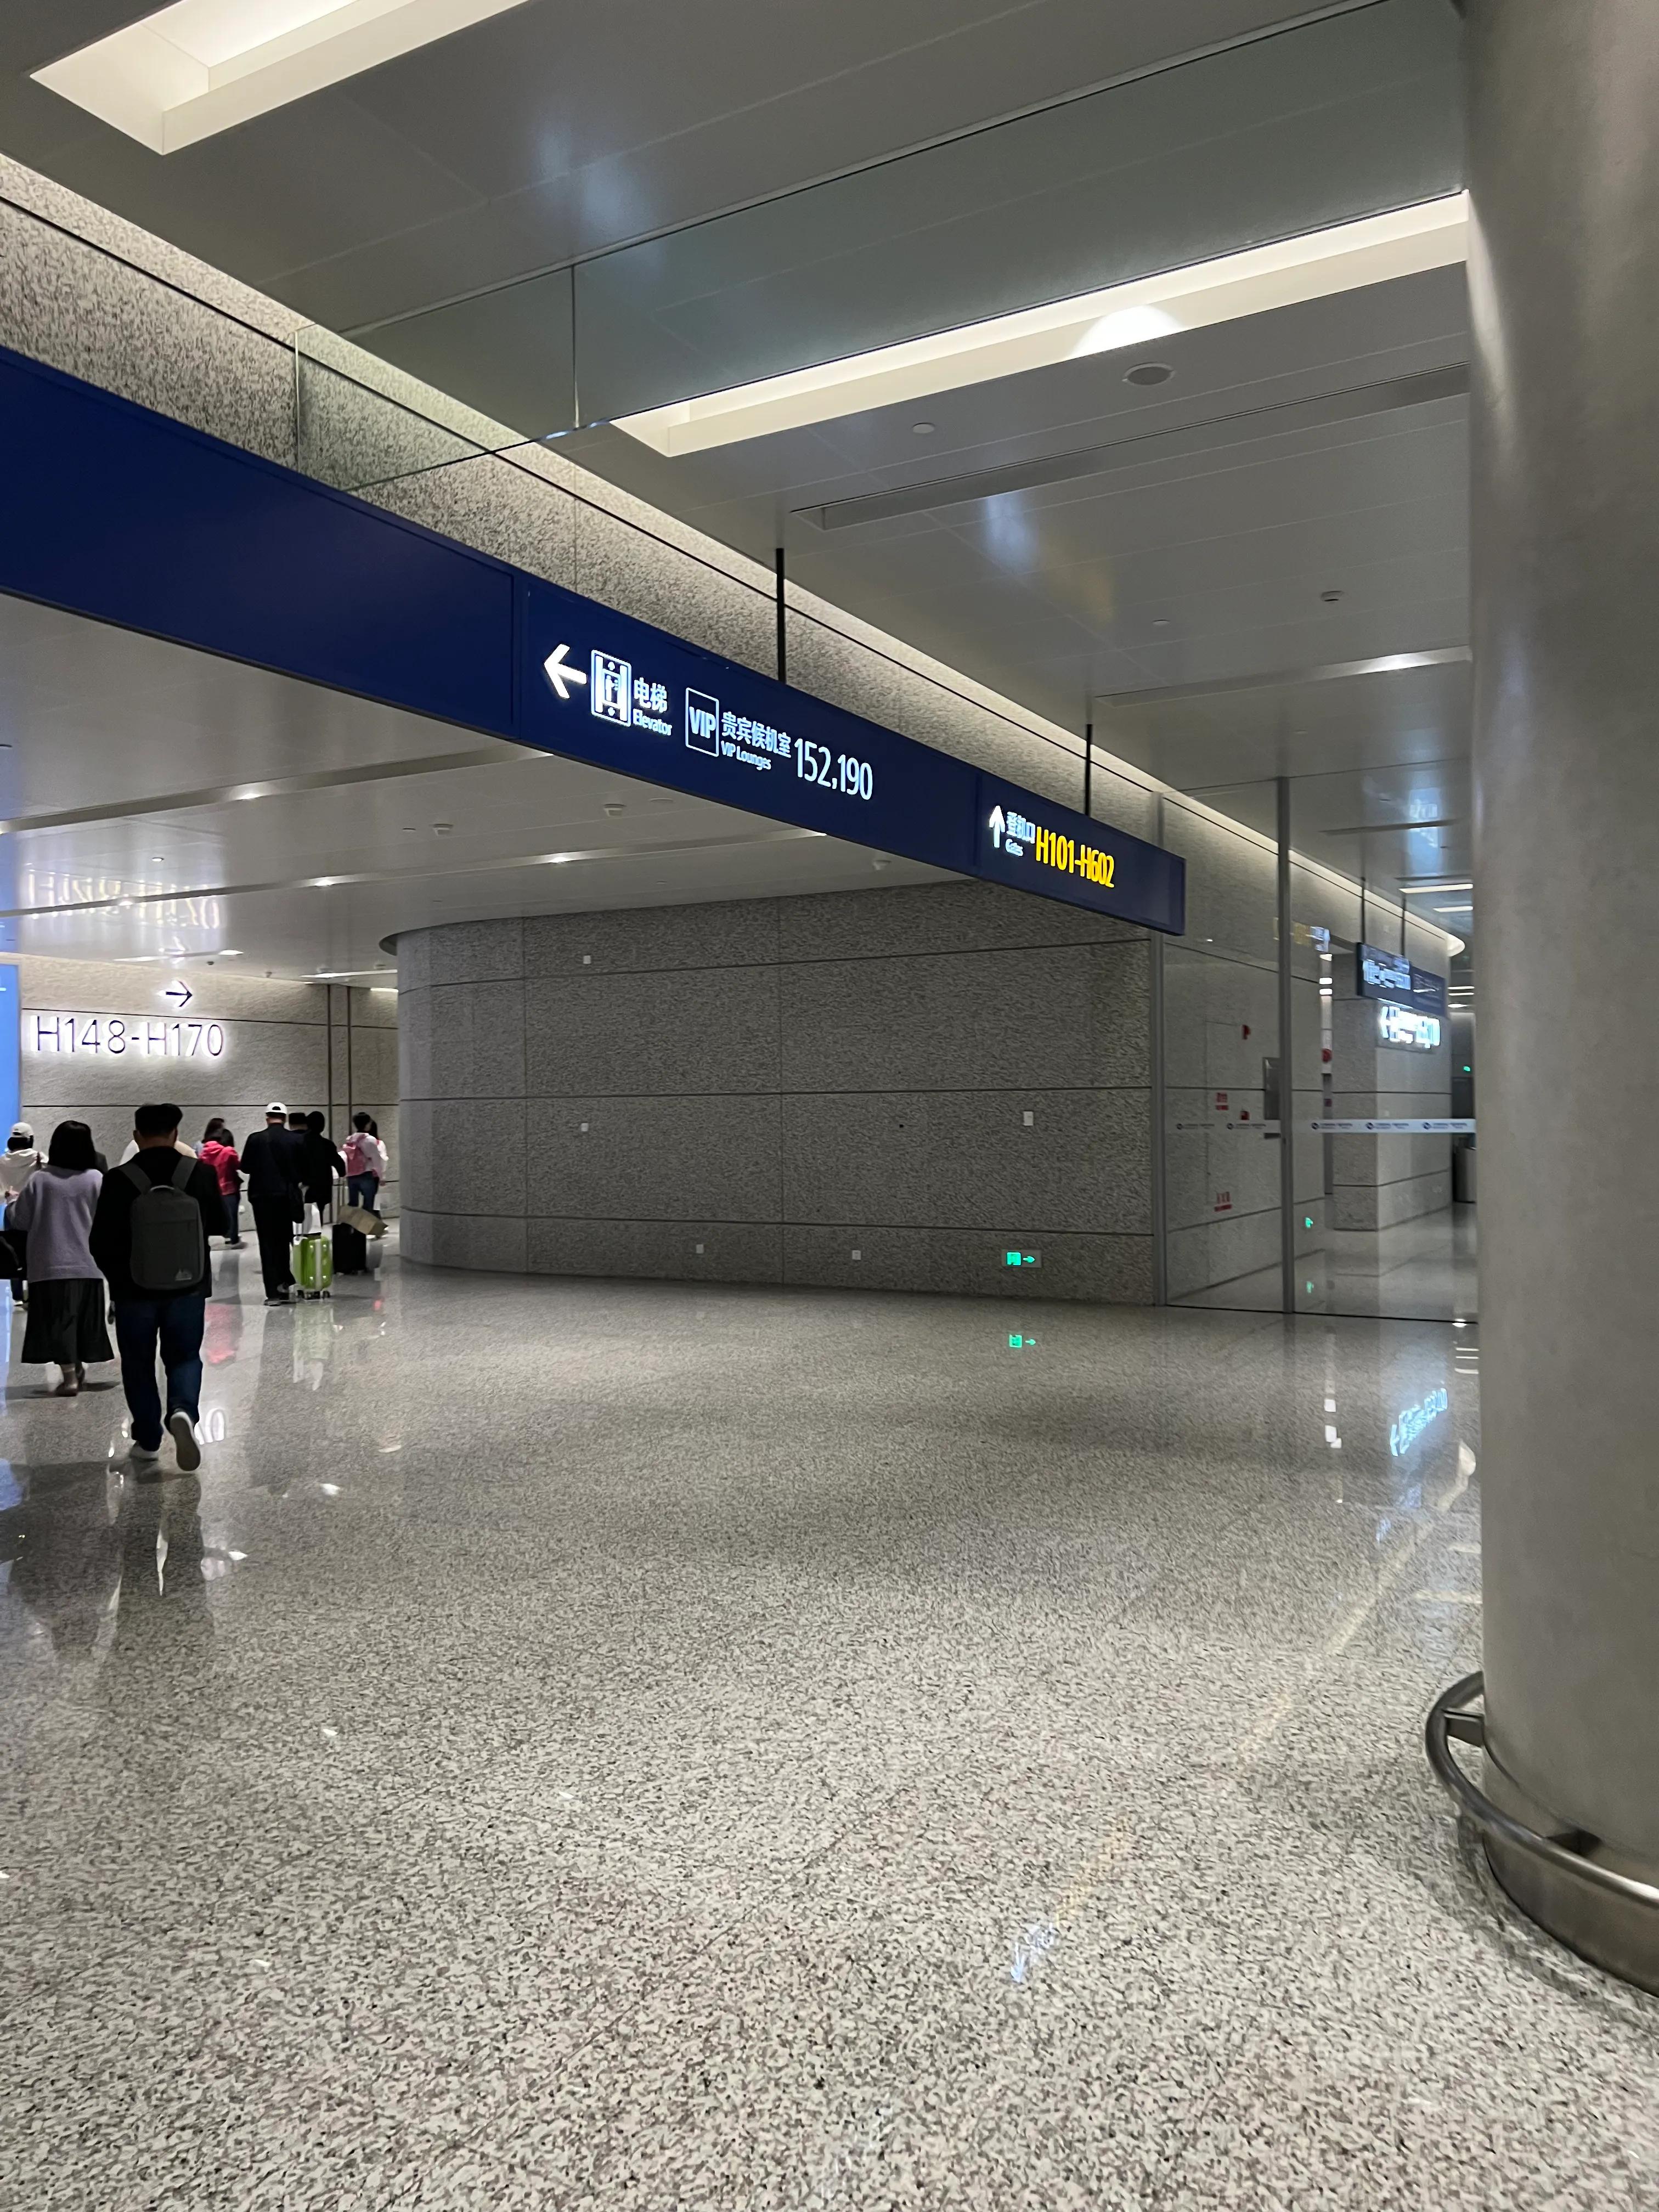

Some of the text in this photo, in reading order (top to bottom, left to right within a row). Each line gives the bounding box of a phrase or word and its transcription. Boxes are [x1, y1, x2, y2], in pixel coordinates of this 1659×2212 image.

[634, 678, 667, 713] 电梯
[633, 708, 672, 736] Elevator
[689, 707, 716, 738] VIP
[721, 741, 771, 770] VIP Lounges
[721, 712, 873, 800] 贵宾候机室 152,190
[1036, 826, 1114, 888] H101-H602
[36, 1016, 224, 1057] H148-H170
